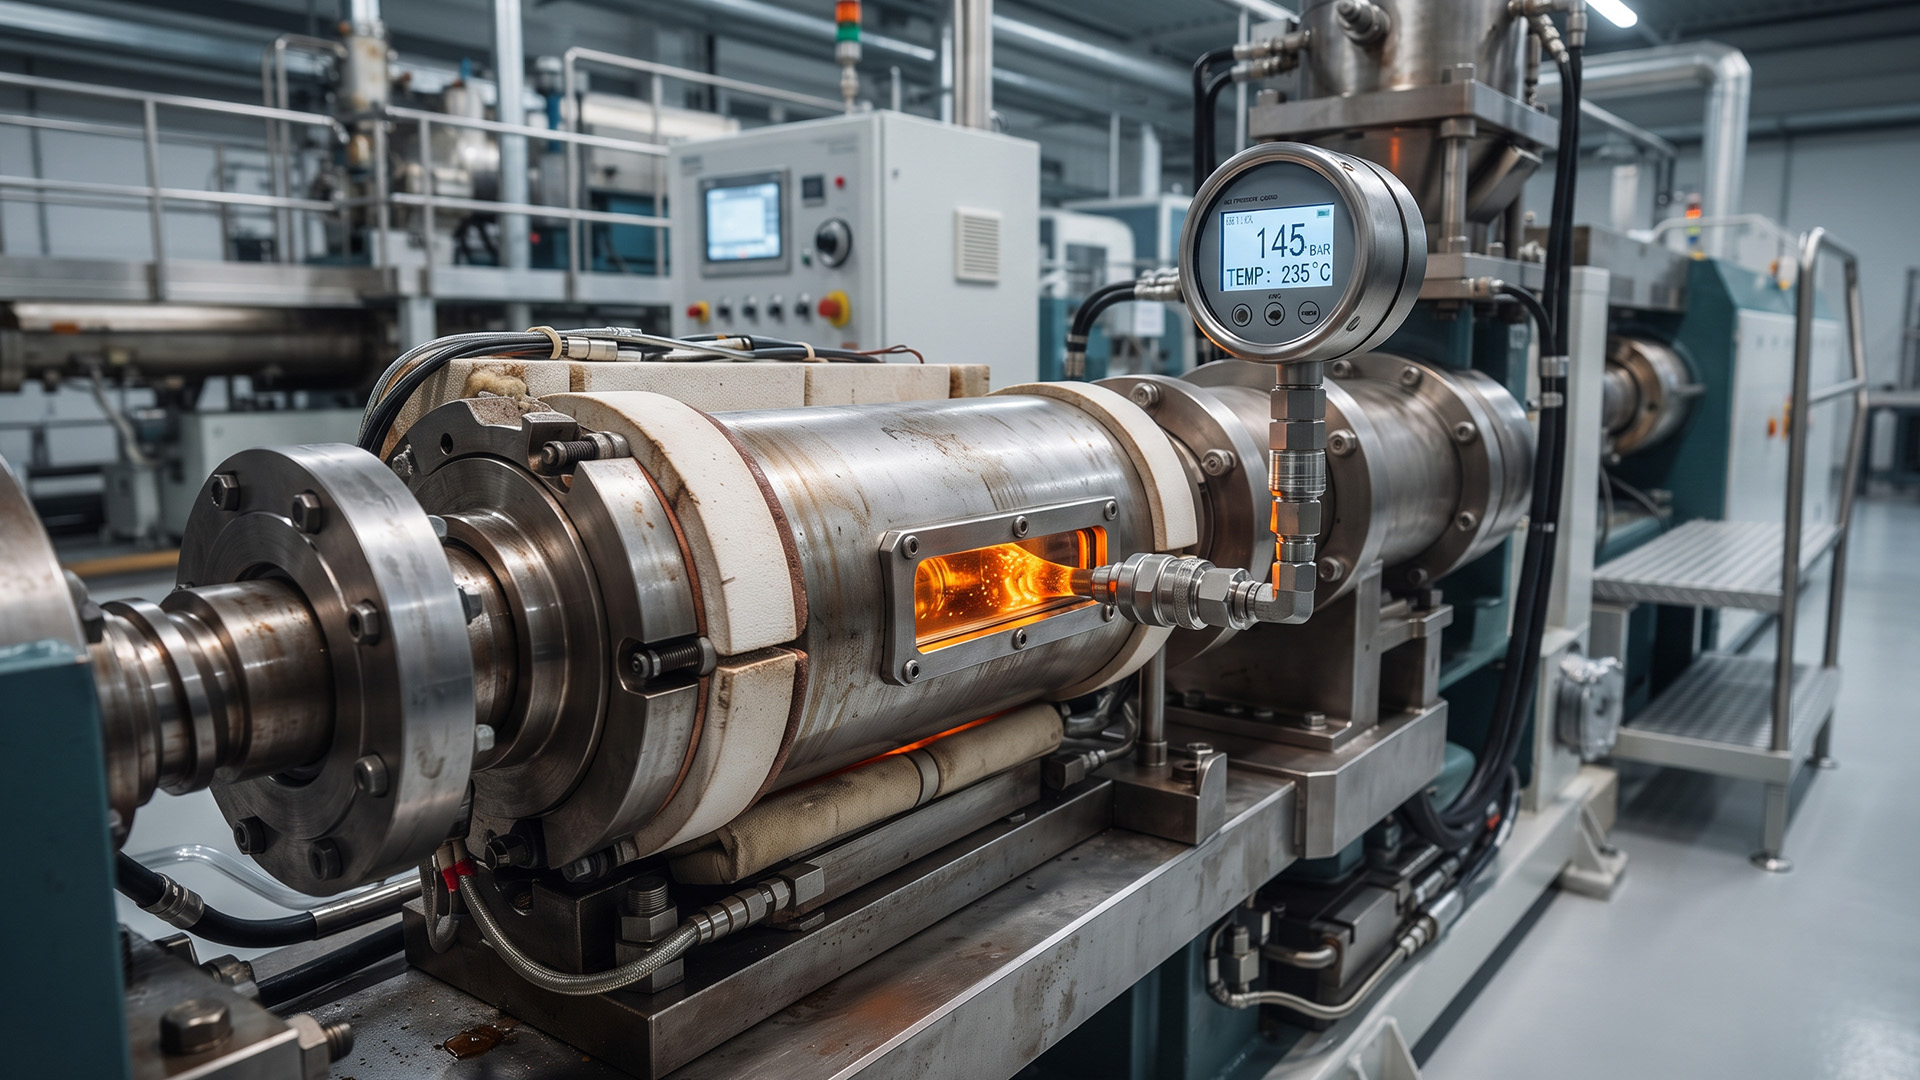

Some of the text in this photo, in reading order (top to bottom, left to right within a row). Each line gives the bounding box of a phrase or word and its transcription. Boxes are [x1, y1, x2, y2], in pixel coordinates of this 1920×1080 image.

[1257, 223, 1331, 258] 145 BAR
[1226, 261, 1331, 287] TEMP: 235°C
